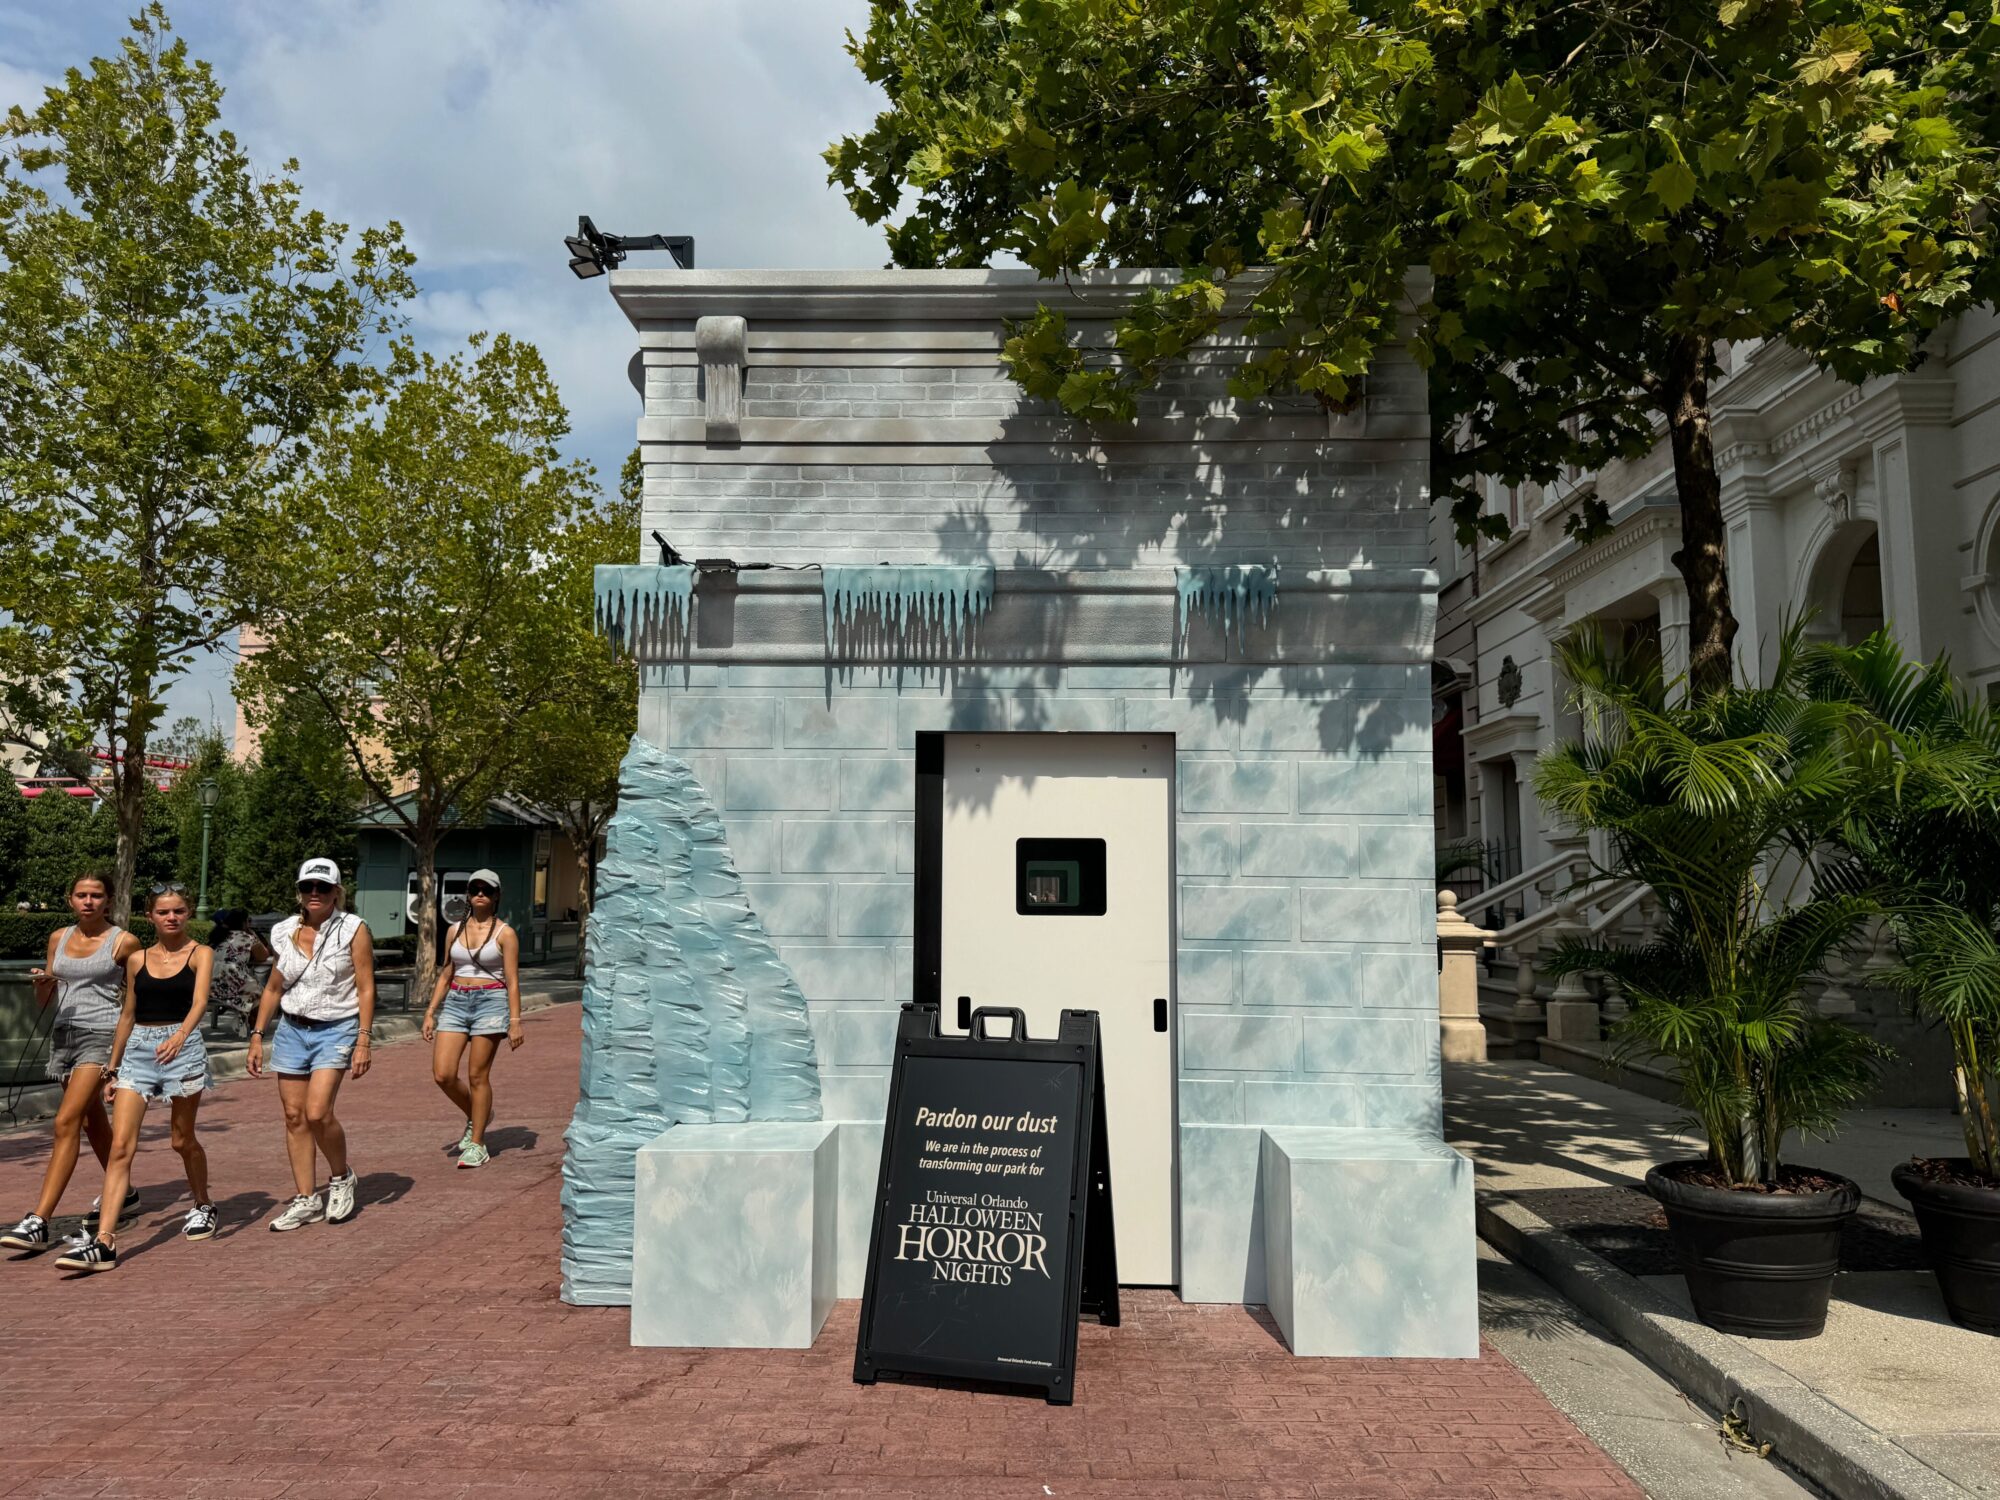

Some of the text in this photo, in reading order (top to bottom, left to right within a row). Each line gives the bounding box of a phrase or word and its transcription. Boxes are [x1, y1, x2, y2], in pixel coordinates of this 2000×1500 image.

[915, 1107, 1058, 1134] Pardon our dust
[925, 1140, 1043, 1158] We are in the process of
[919, 1157, 1044, 1177] transforming our park for
[926, 1190, 1029, 1209] Universal Orlando
[908, 1203, 1044, 1232] HALLOWEEN
[893, 1224, 1051, 1280] HORROR
[932, 1260, 1012, 1286] NIGHTS
